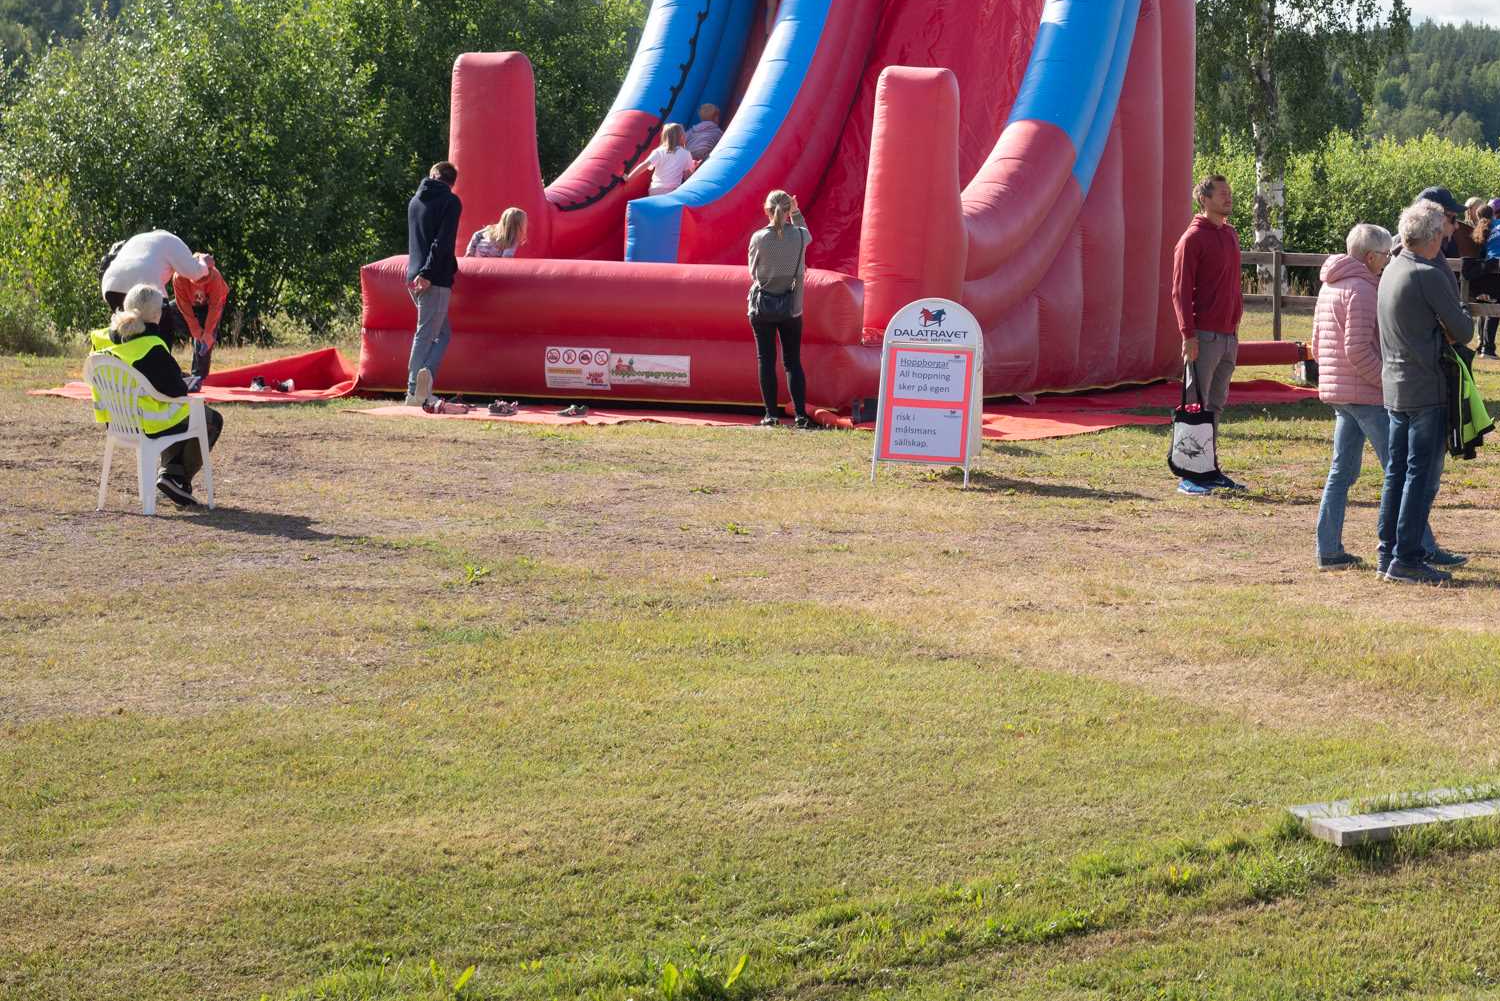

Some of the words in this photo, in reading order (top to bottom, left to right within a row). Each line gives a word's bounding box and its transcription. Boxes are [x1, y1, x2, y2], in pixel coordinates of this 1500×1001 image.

[894, 328, 969, 339] DALATRAVET
[899, 369, 910, 377] All
[912, 370, 951, 382] hoppning
[917, 383, 928, 392] på
[896, 412, 912, 421] risk
[895, 425, 937, 435] målsmans
